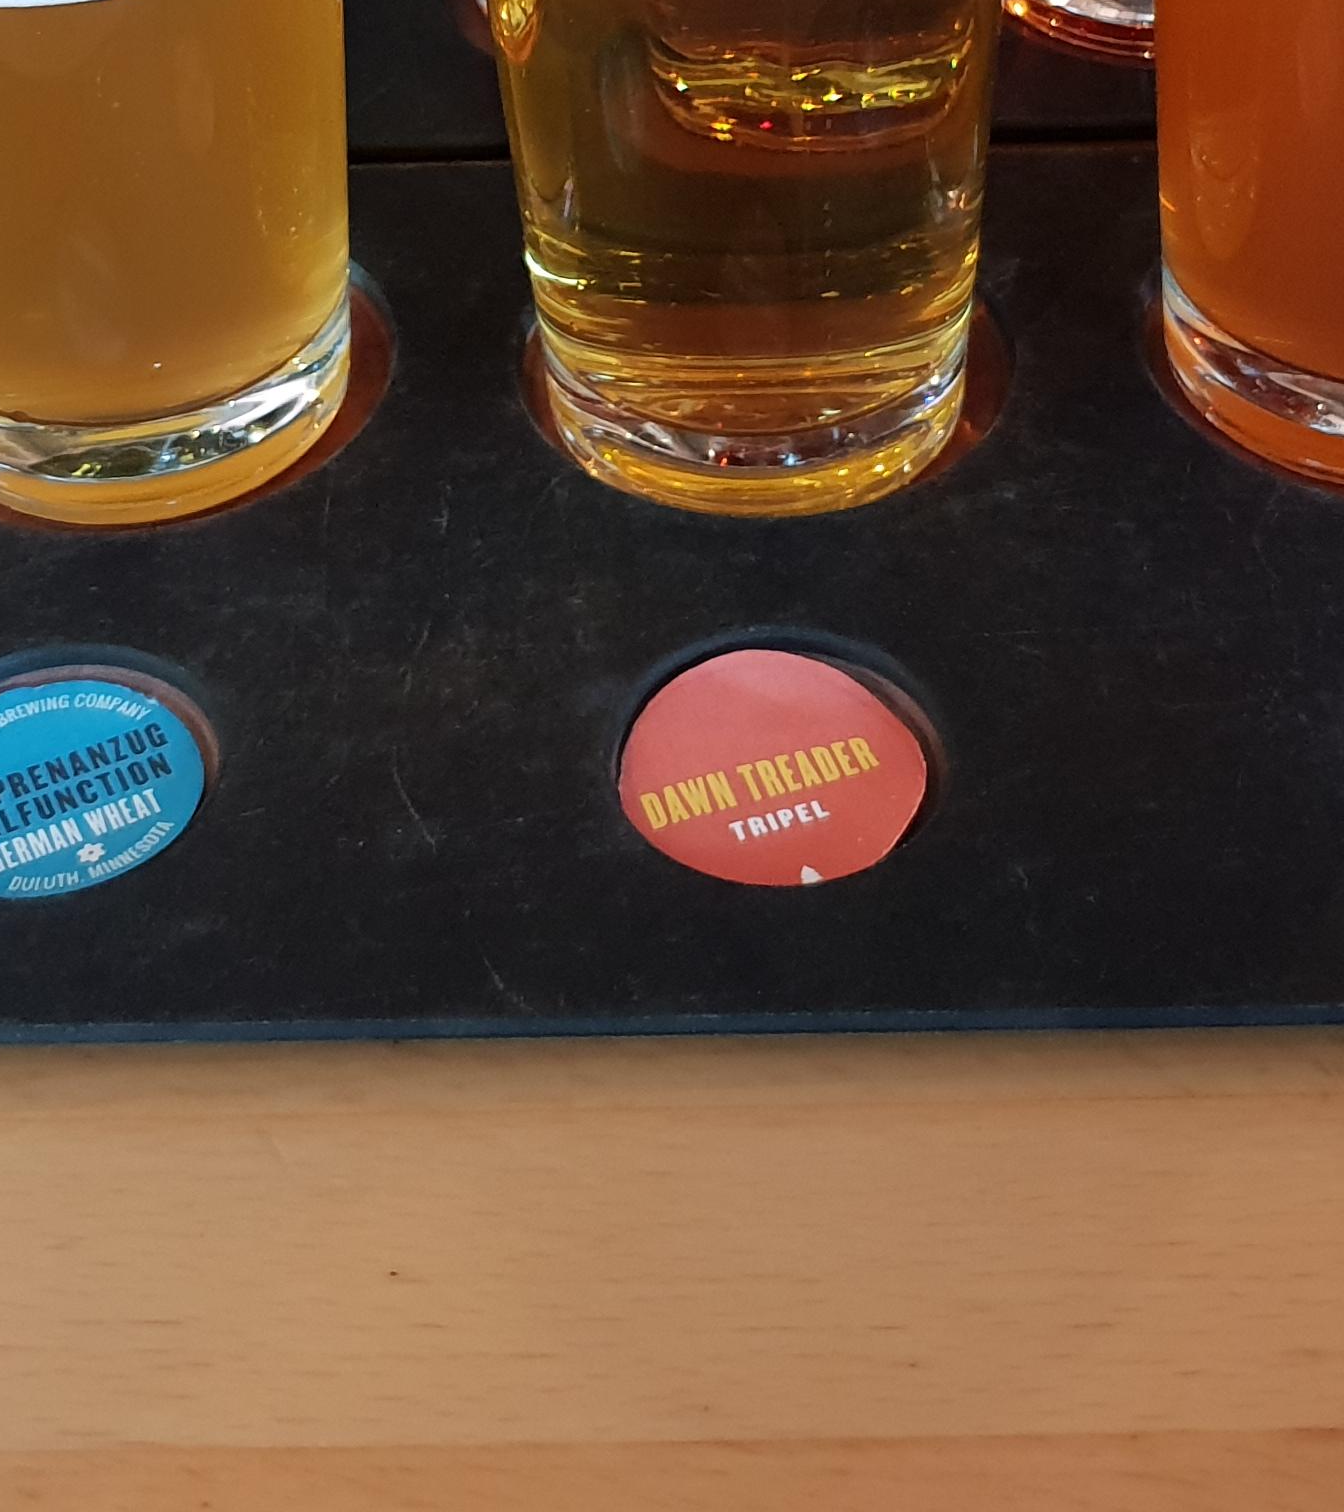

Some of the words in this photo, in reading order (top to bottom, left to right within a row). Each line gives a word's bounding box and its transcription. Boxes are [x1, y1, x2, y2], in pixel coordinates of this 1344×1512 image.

[73, 693, 153, 721] COMPANY
[639, 770, 738, 830] DAWN
[736, 736, 880, 802] TREADER
[83, 788, 162, 836] WHEAT
[728, 799, 831, 843] TRIPEL
[87, 819, 175, 879] MINNESOTA
